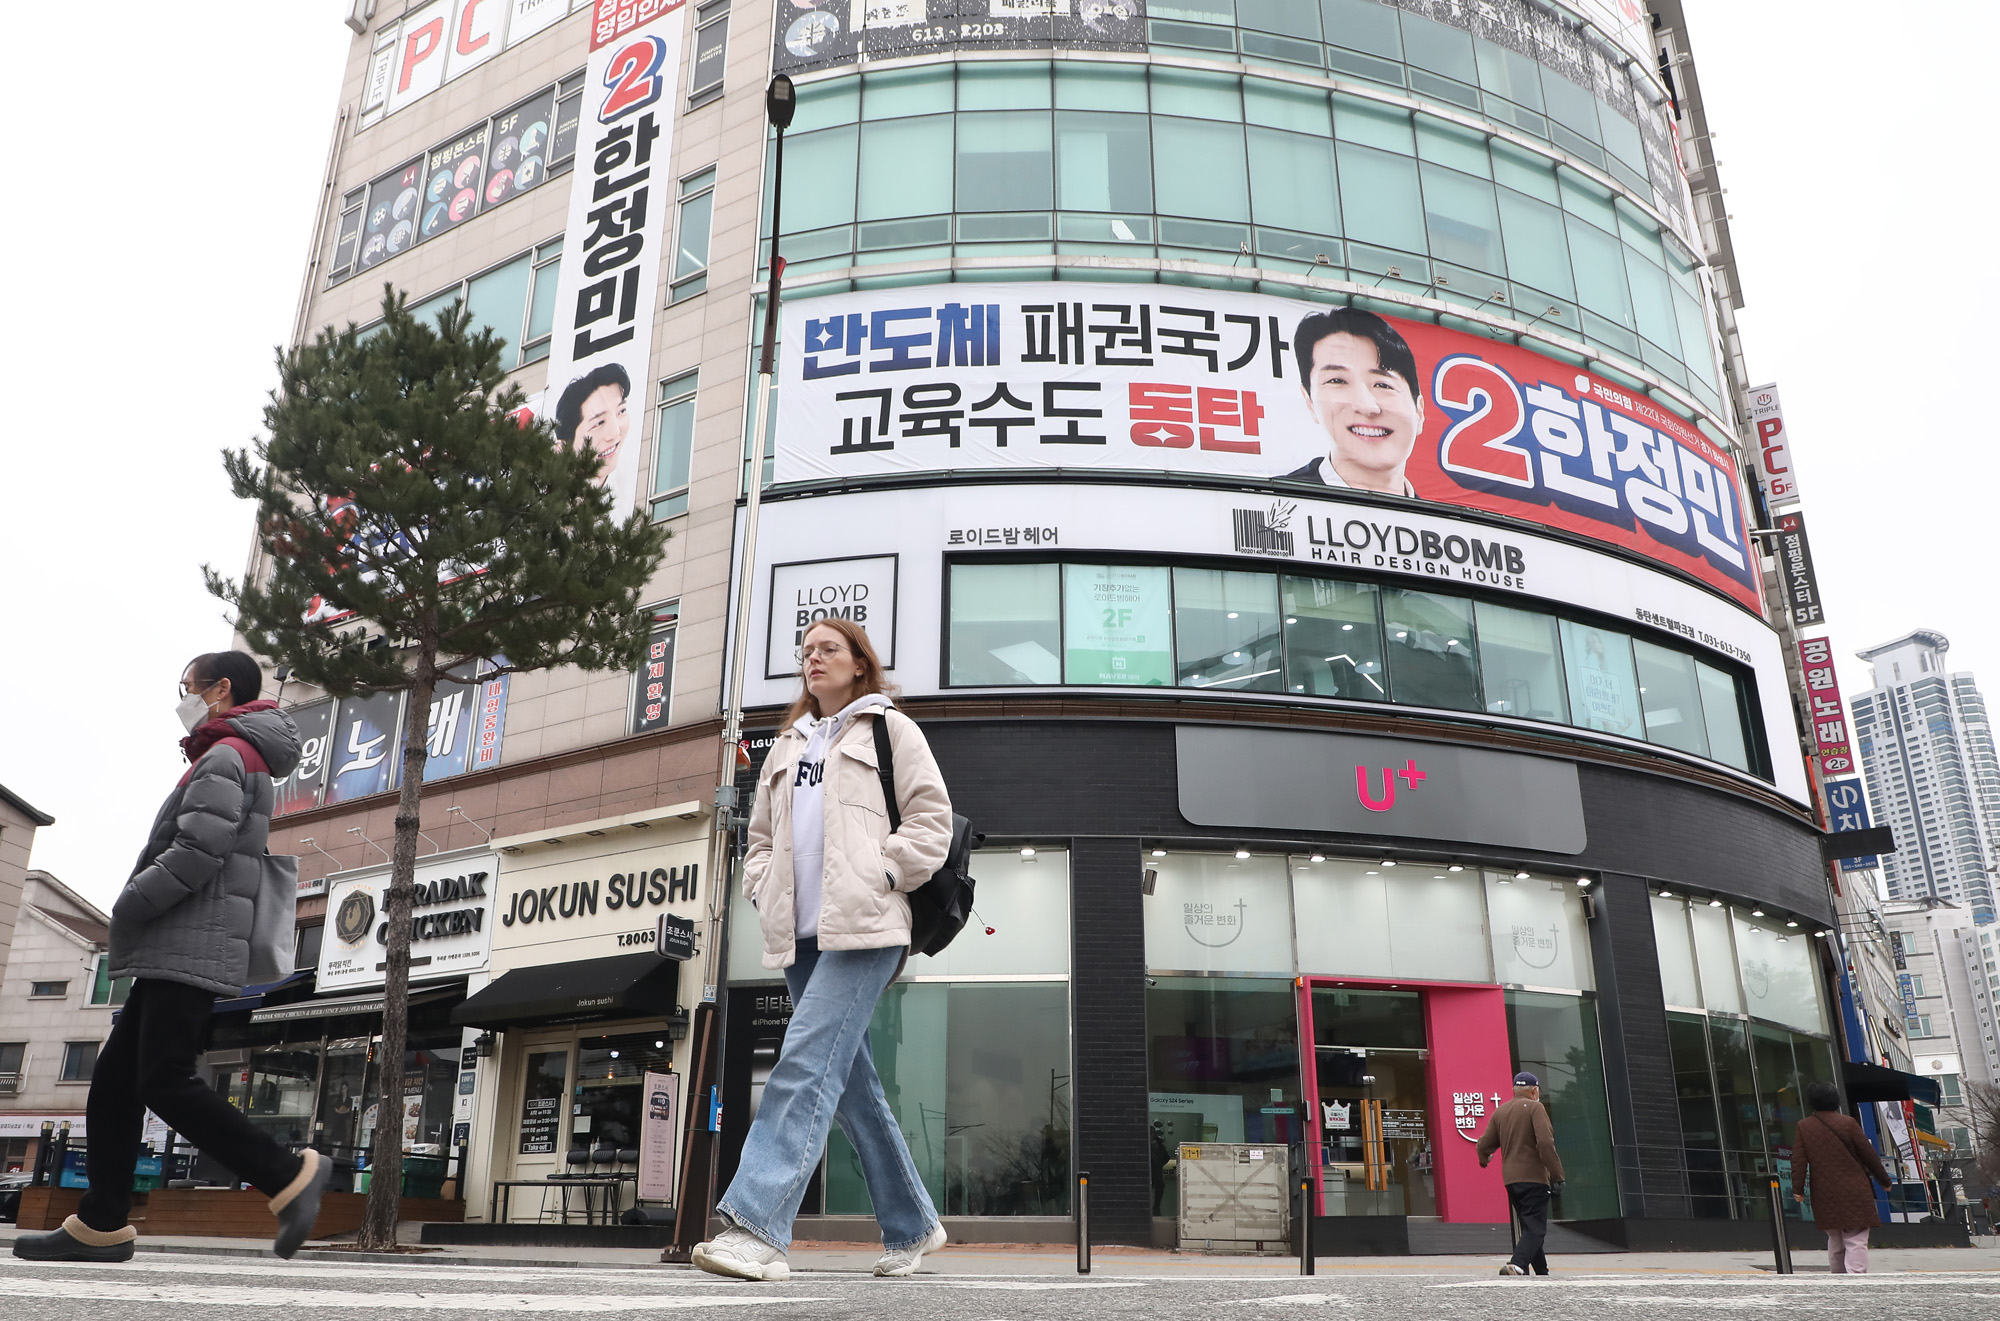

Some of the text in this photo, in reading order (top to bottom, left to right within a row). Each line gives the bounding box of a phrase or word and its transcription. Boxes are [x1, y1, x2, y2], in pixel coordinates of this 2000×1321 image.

[398, 0, 490, 95] PC
[372, 53, 389, 102] TRIPLE
[598, 34, 667, 125] 2
[500, 114, 519, 134] 5F
[430, 128, 487, 170] 점핑몬스터
[573, 112, 659, 361] 한정민
[802, 302, 1290, 381] 반도체 패권국가
[830, 382, 1264, 456] 교육수도 동탄
[1432, 353, 1535, 489] 2
[1593, 383, 1633, 411] 국민의힘
[1634, 401, 1660, 423] 제22대
[1754, 405, 1780, 416] TRIPLE
[1756, 417, 1788, 475] PC
[1526, 384, 1746, 572] 한정민
[1770, 478, 1792, 495] 6F
[948, 526, 1059, 545] 로이드밤 헤어
[1308, 515, 1526, 575] LLOYDBOMB
[1312, 548, 1525, 590] HAIR DESIGN HOUSE
[1784, 534, 1812, 604] 점핑몬스터
[797, 584, 869, 606] LLOYD
[1796, 605, 1820, 622] 5F
[1102, 608, 1132, 628] 2F
[1636, 608, 1695, 638] 동탄센트럴파크점
[646, 642, 666, 720] 단체환영
[1803, 639, 1846, 743] 공원노래
[271, 690, 465, 787] 원노래
[480, 682, 502, 763] 대형룸완비
[1822, 746, 1848, 756] 연습장
[1831, 758, 1846, 770] 2F
[1354, 759, 1427, 812] U+
[502, 864, 698, 927] JOKUN SUSHI
[1184, 902, 1213, 914] 일상의
[376, 907, 484, 946] CICKEN
[1184, 914, 1237, 926] 즐거운 변화
[1512, 925, 1534, 936] 일상의
[1537, 938, 1552, 949] 변화
[597, 996, 614, 1004] sushi
[1453, 1092, 1484, 1104] 일상의
[1453, 1104, 1484, 1116] 즐거운
[1455, 1117, 1476, 1129] 변화
[1188, 1149, 1199, 1158] 1-1
